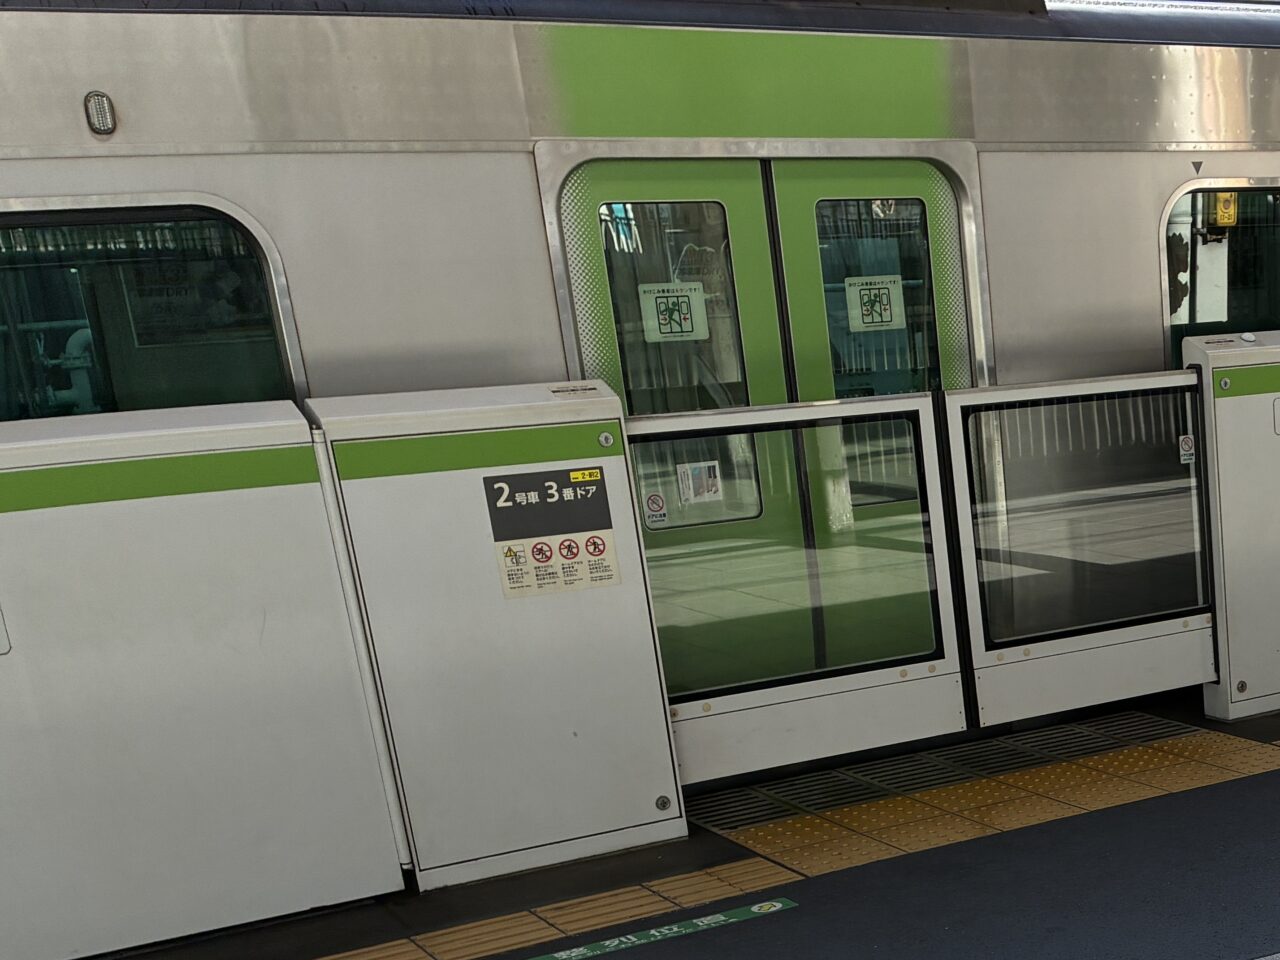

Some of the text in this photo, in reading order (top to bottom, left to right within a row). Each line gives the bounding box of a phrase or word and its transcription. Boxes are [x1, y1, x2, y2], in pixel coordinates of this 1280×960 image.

[493, 481, 597, 507] 2号車 3番ドア
